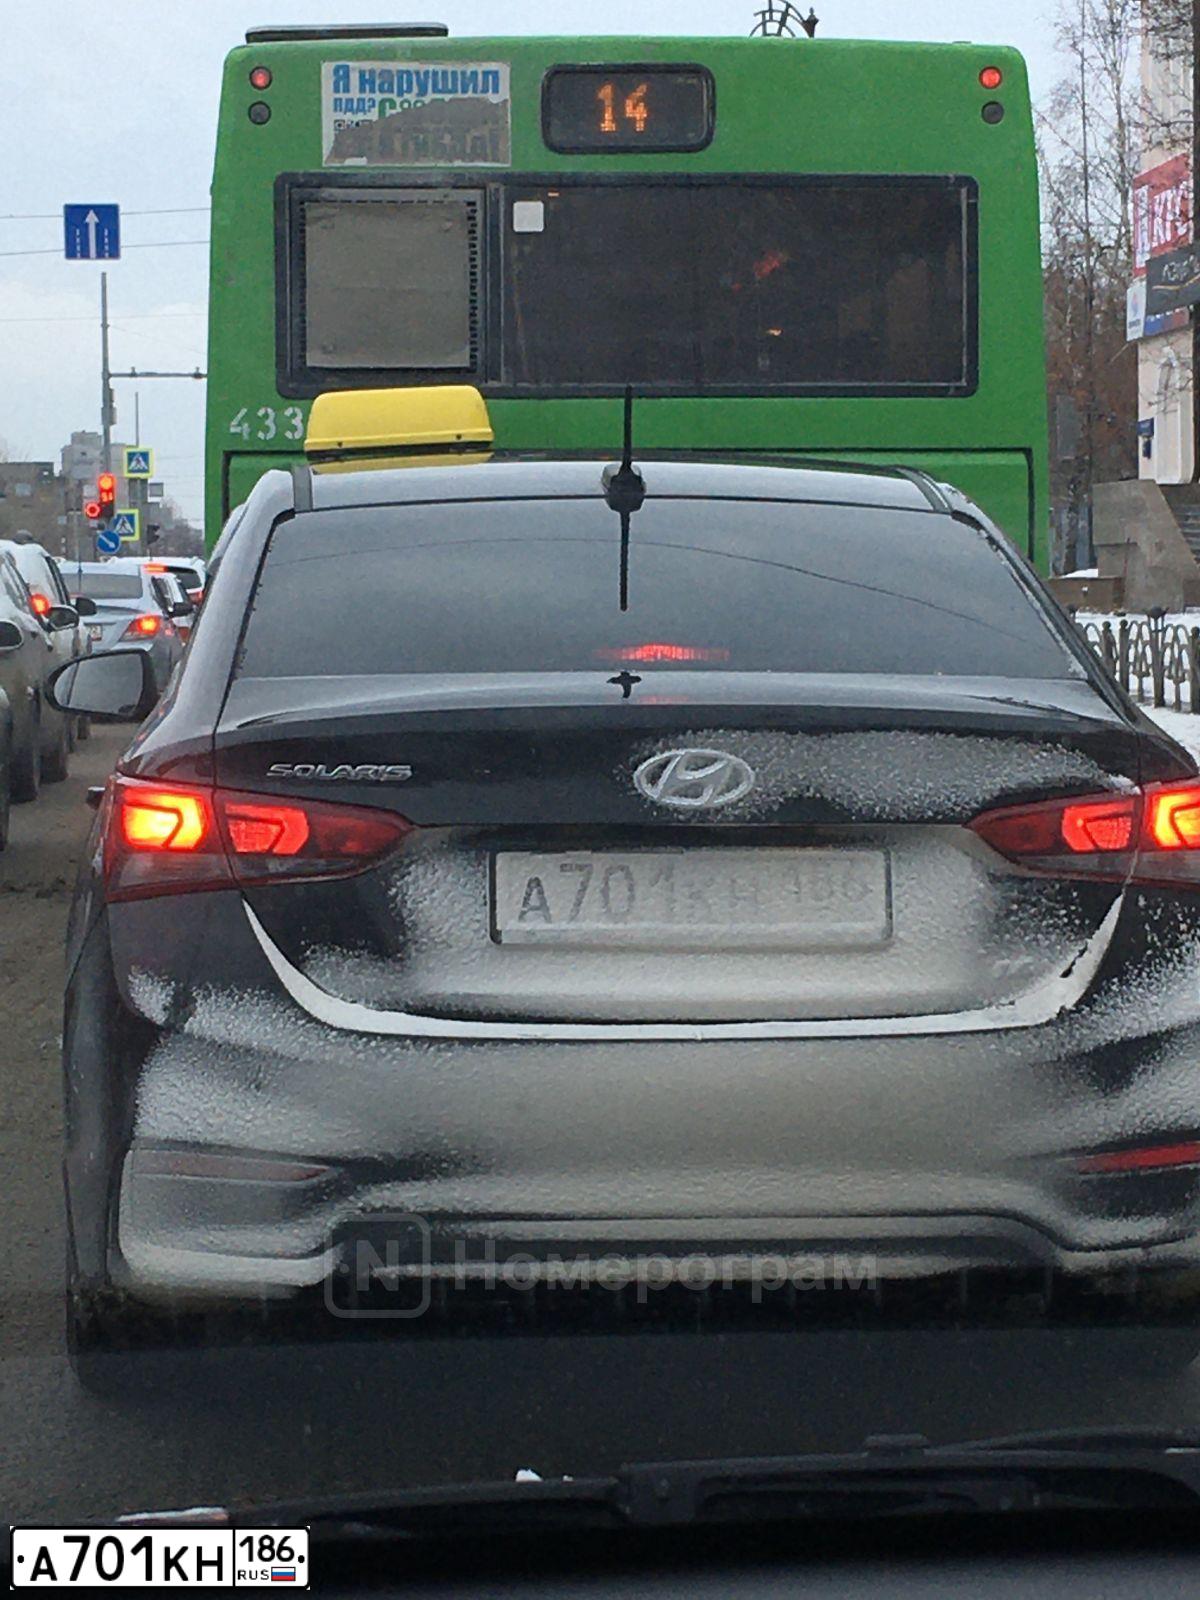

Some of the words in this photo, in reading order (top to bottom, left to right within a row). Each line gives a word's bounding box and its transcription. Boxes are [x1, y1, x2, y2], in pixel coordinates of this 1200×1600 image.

[332, 64, 350, 94] Я
[358, 68, 500, 97] нарушил
[598, 83, 648, 132] 14
[229, 406, 304, 441] 433
[266, 763, 413, 782] SOLARIS
